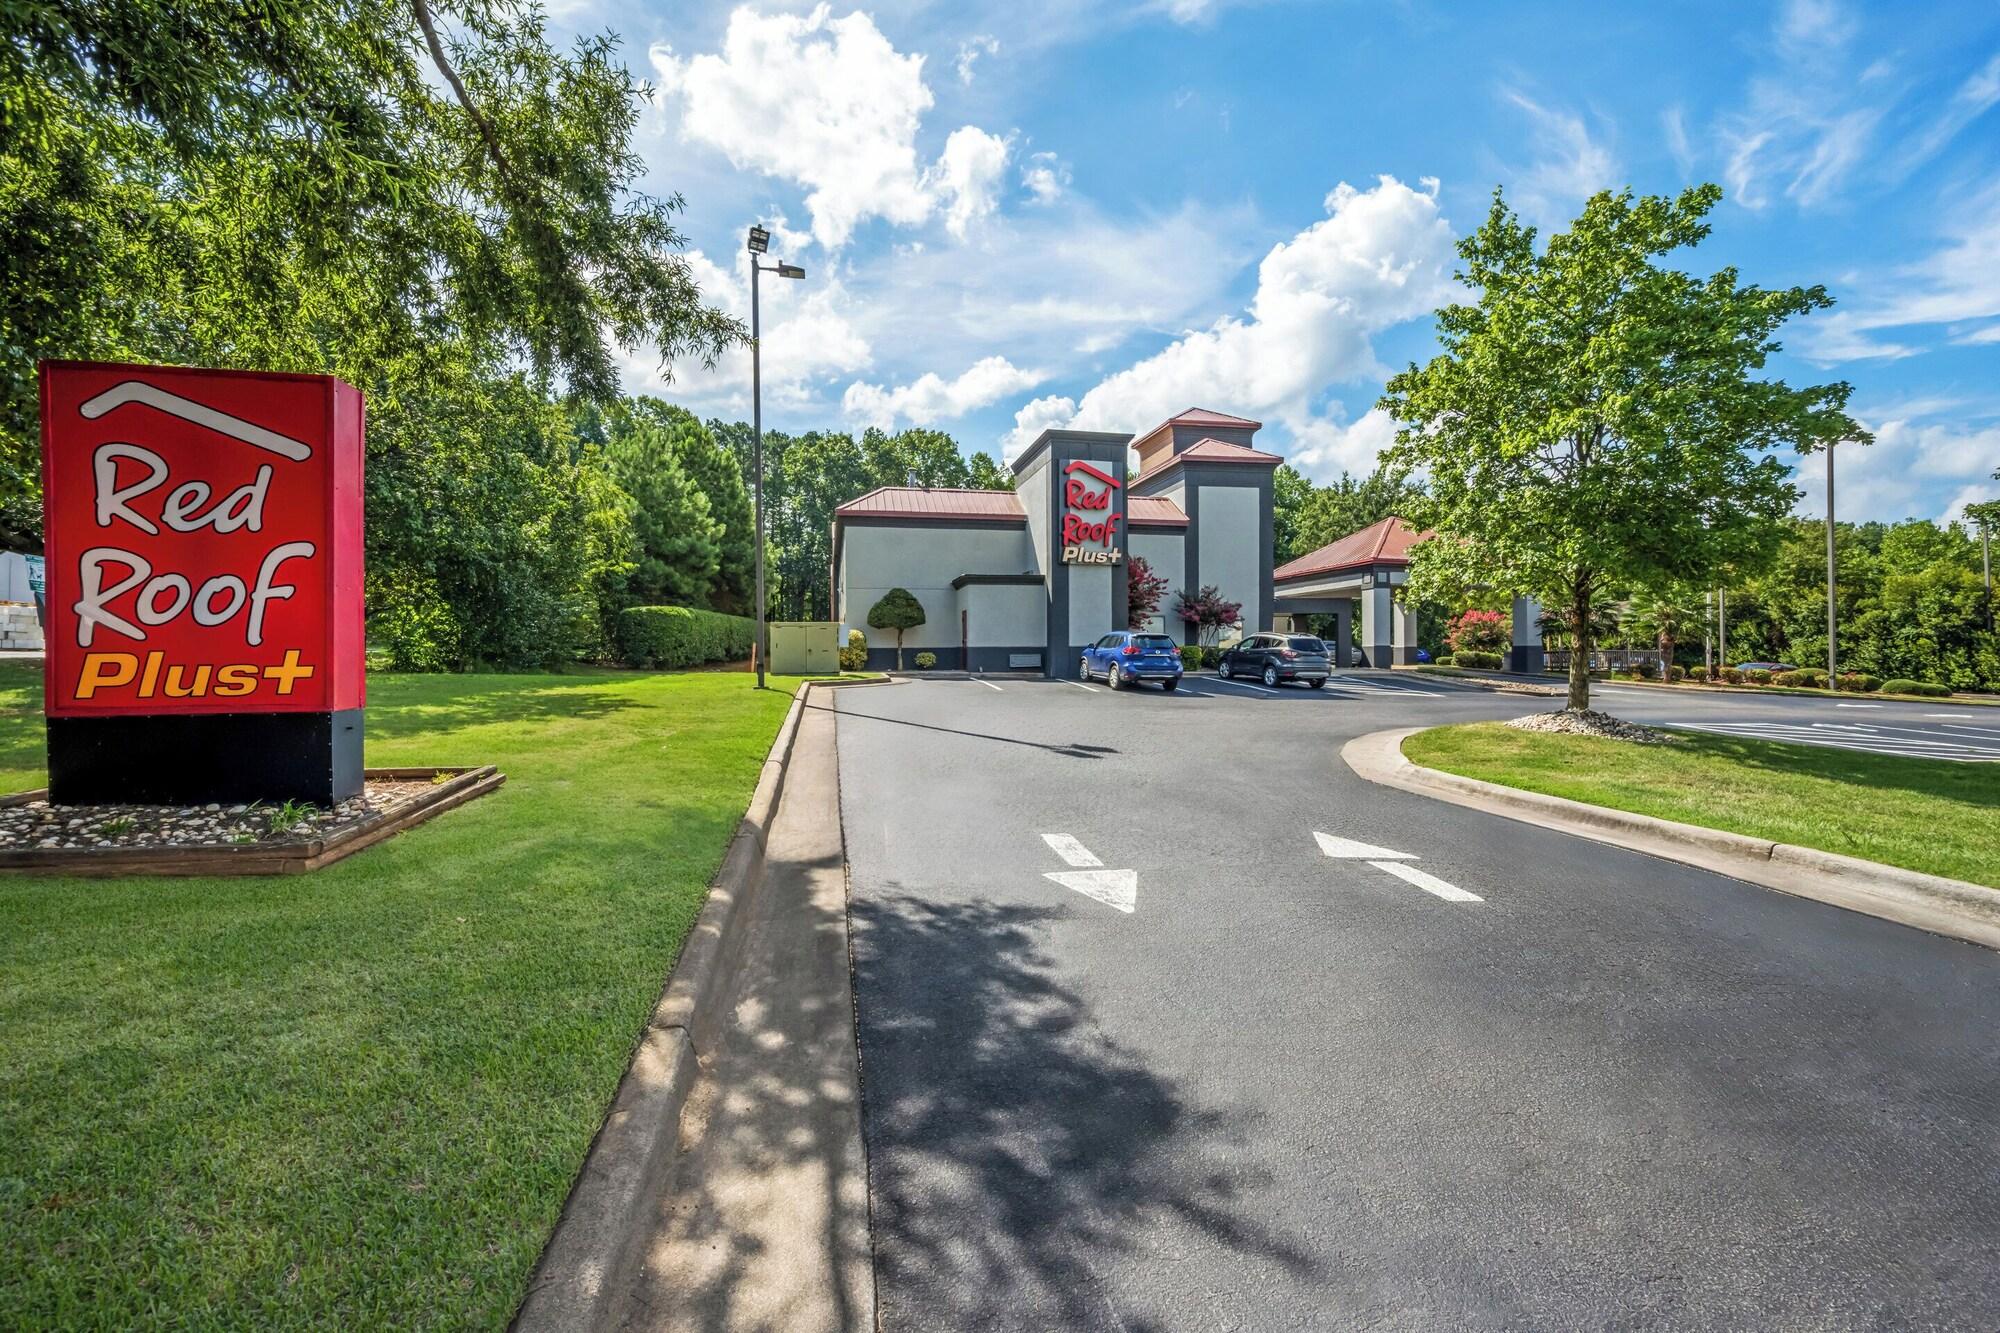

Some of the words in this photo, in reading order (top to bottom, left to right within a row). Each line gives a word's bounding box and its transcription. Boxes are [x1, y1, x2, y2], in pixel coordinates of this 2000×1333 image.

[94, 442, 273, 535] Red
[1066, 479, 1112, 510] Red
[1063, 512, 1122, 547] Roof
[1062, 546, 1121, 563] Plus+
[74, 541, 316, 647] Roof
[74, 650, 314, 699] Plus+
